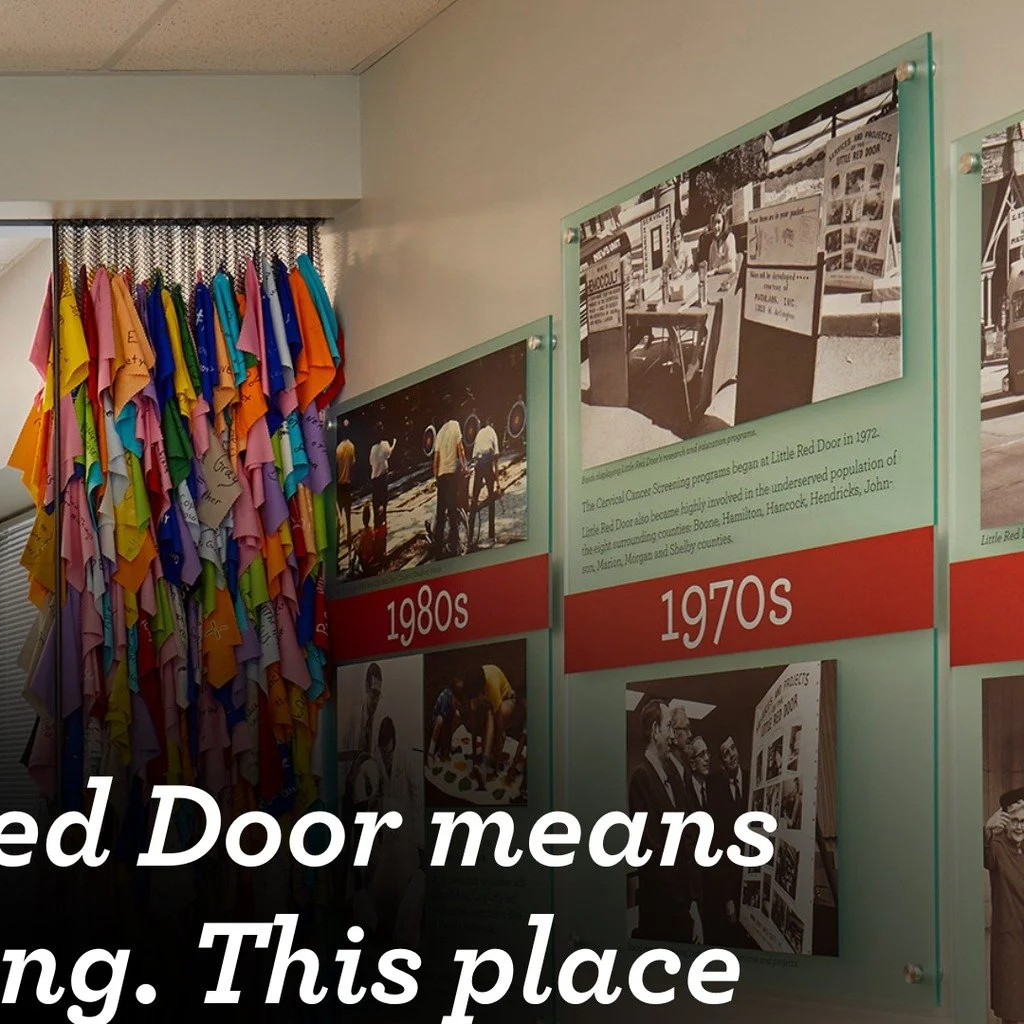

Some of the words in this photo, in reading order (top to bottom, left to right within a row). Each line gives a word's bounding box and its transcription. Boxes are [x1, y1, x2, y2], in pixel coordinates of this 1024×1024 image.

[865, 143, 881, 157] DOOR
[581, 522, 599, 538] Little
[600, 518, 614, 533] Red
[616, 516, 634, 531] Door
[634, 512, 650, 526] also
[650, 507, 680, 523] became
[680, 496, 707, 516] highly
[708, 487, 743, 510] involved
[744, 488, 754, 500] in
[756, 482, 770, 497] the
[772, 466, 828, 492] underserved
[830, 457, 884, 483] population
[886, 449, 898, 466] of
[582, 499, 595, 513] The
[596, 491, 625, 509] Cervical
[626, 487, 651, 502] Cancer
[652, 475, 690, 495] Screening
[692, 466, 731, 488] programs
[732, 459, 759, 475] began
[760, 456, 770, 468] at
[771, 446, 795, 464] Little
[796, 439, 814, 458] Red
[817, 437, 842, 453] Door
[844, 433, 854, 446] in
[856, 427, 880, 445] 1972.
[581, 543, 594, 557] the
[594, 540, 612, 555] eight
[613, 529, 656, 551] surrounding
[658, 523, 692, 539] counties:
[693, 518, 721, 532] Boone,
[722, 506, 764, 527] Hamilton,
[766, 493, 809, 516] Hancock,
[810, 483, 862, 507] Hendricks,
[864, 476, 893, 495] John-
[980, 531, 1003, 546] Little
[1004, 527, 1020, 542] Red
[581, 564, 596, 574] son,
[596, 558, 624, 572] Marion,
[624, 552, 653, 566] Morgan
[654, 546, 668, 559] and
[670, 539, 696, 556] Shelby
[697, 533, 734, 550] counties.
[386, 585, 469, 647] 1980s
[660, 574, 793, 649] 1970s
